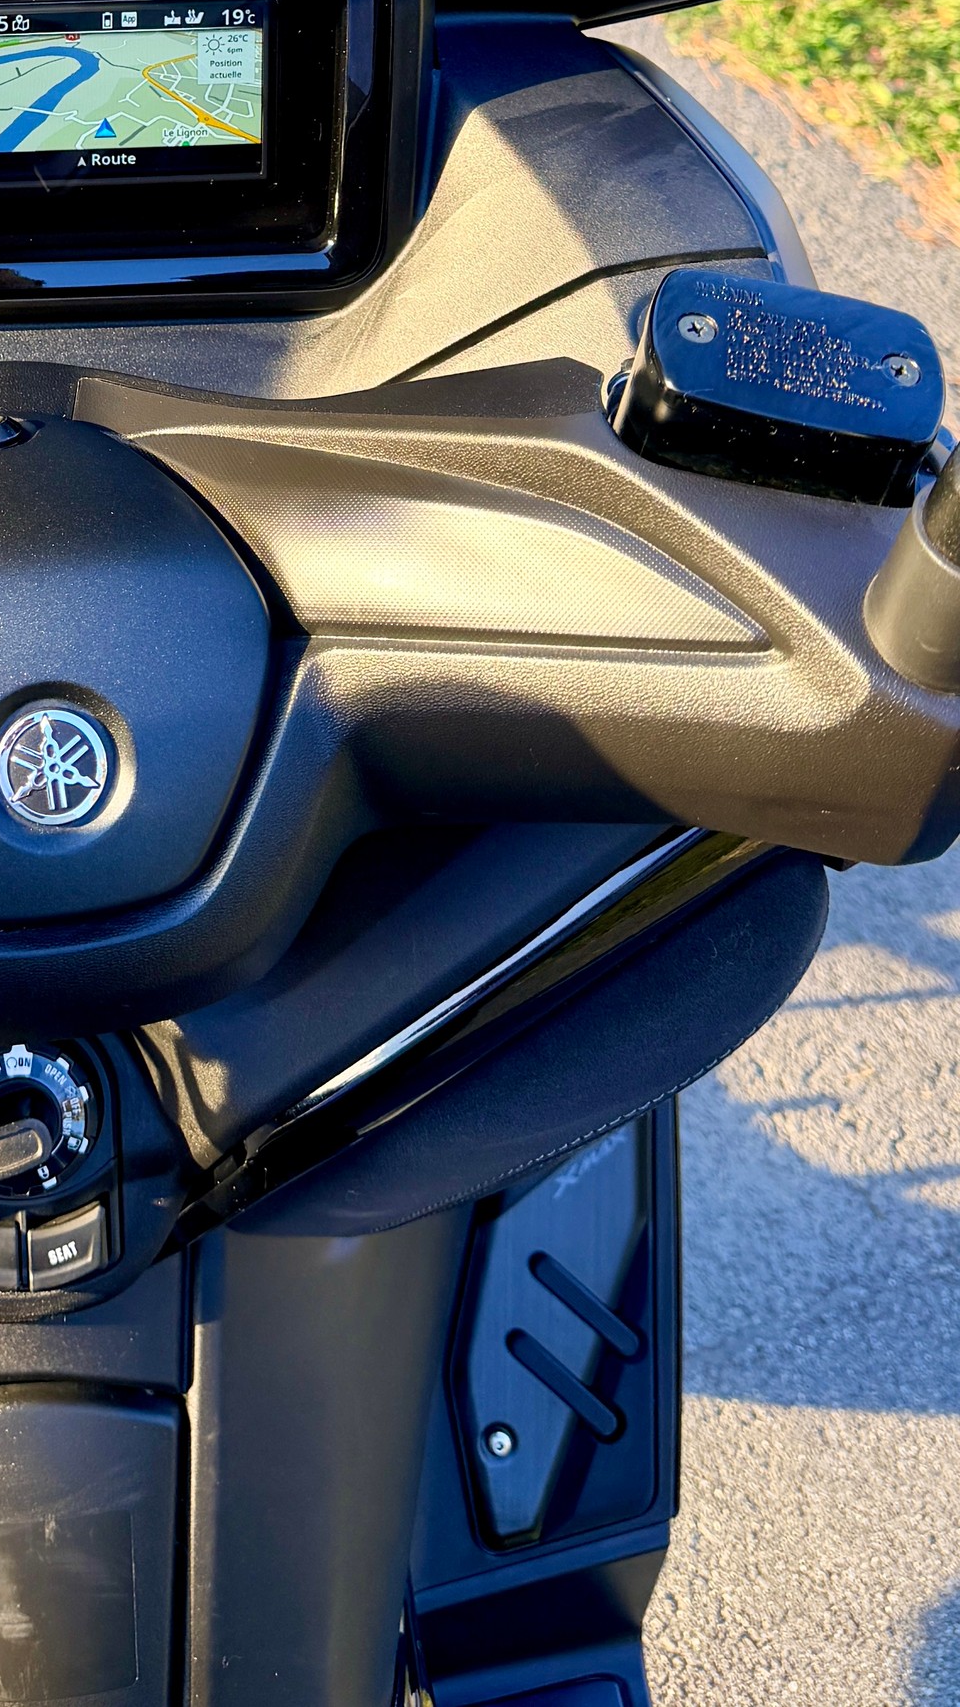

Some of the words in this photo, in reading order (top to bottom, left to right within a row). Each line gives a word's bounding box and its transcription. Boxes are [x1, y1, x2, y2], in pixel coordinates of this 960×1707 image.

[122, 15, 136, 24] App
[227, 34, 249, 43] 26°C
[227, 47, 243, 55] 6pm
[210, 59, 243, 67] Position
[210, 71, 242, 79] actuelle
[163, 129, 174, 137] Le
[176, 128, 208, 139] Lignon
[91, 153, 137, 166] Route
[18, 1057, 31, 1067] ON
[44, 1063, 68, 1085] OPEN
[47, 1240, 78, 1266] SEAT
